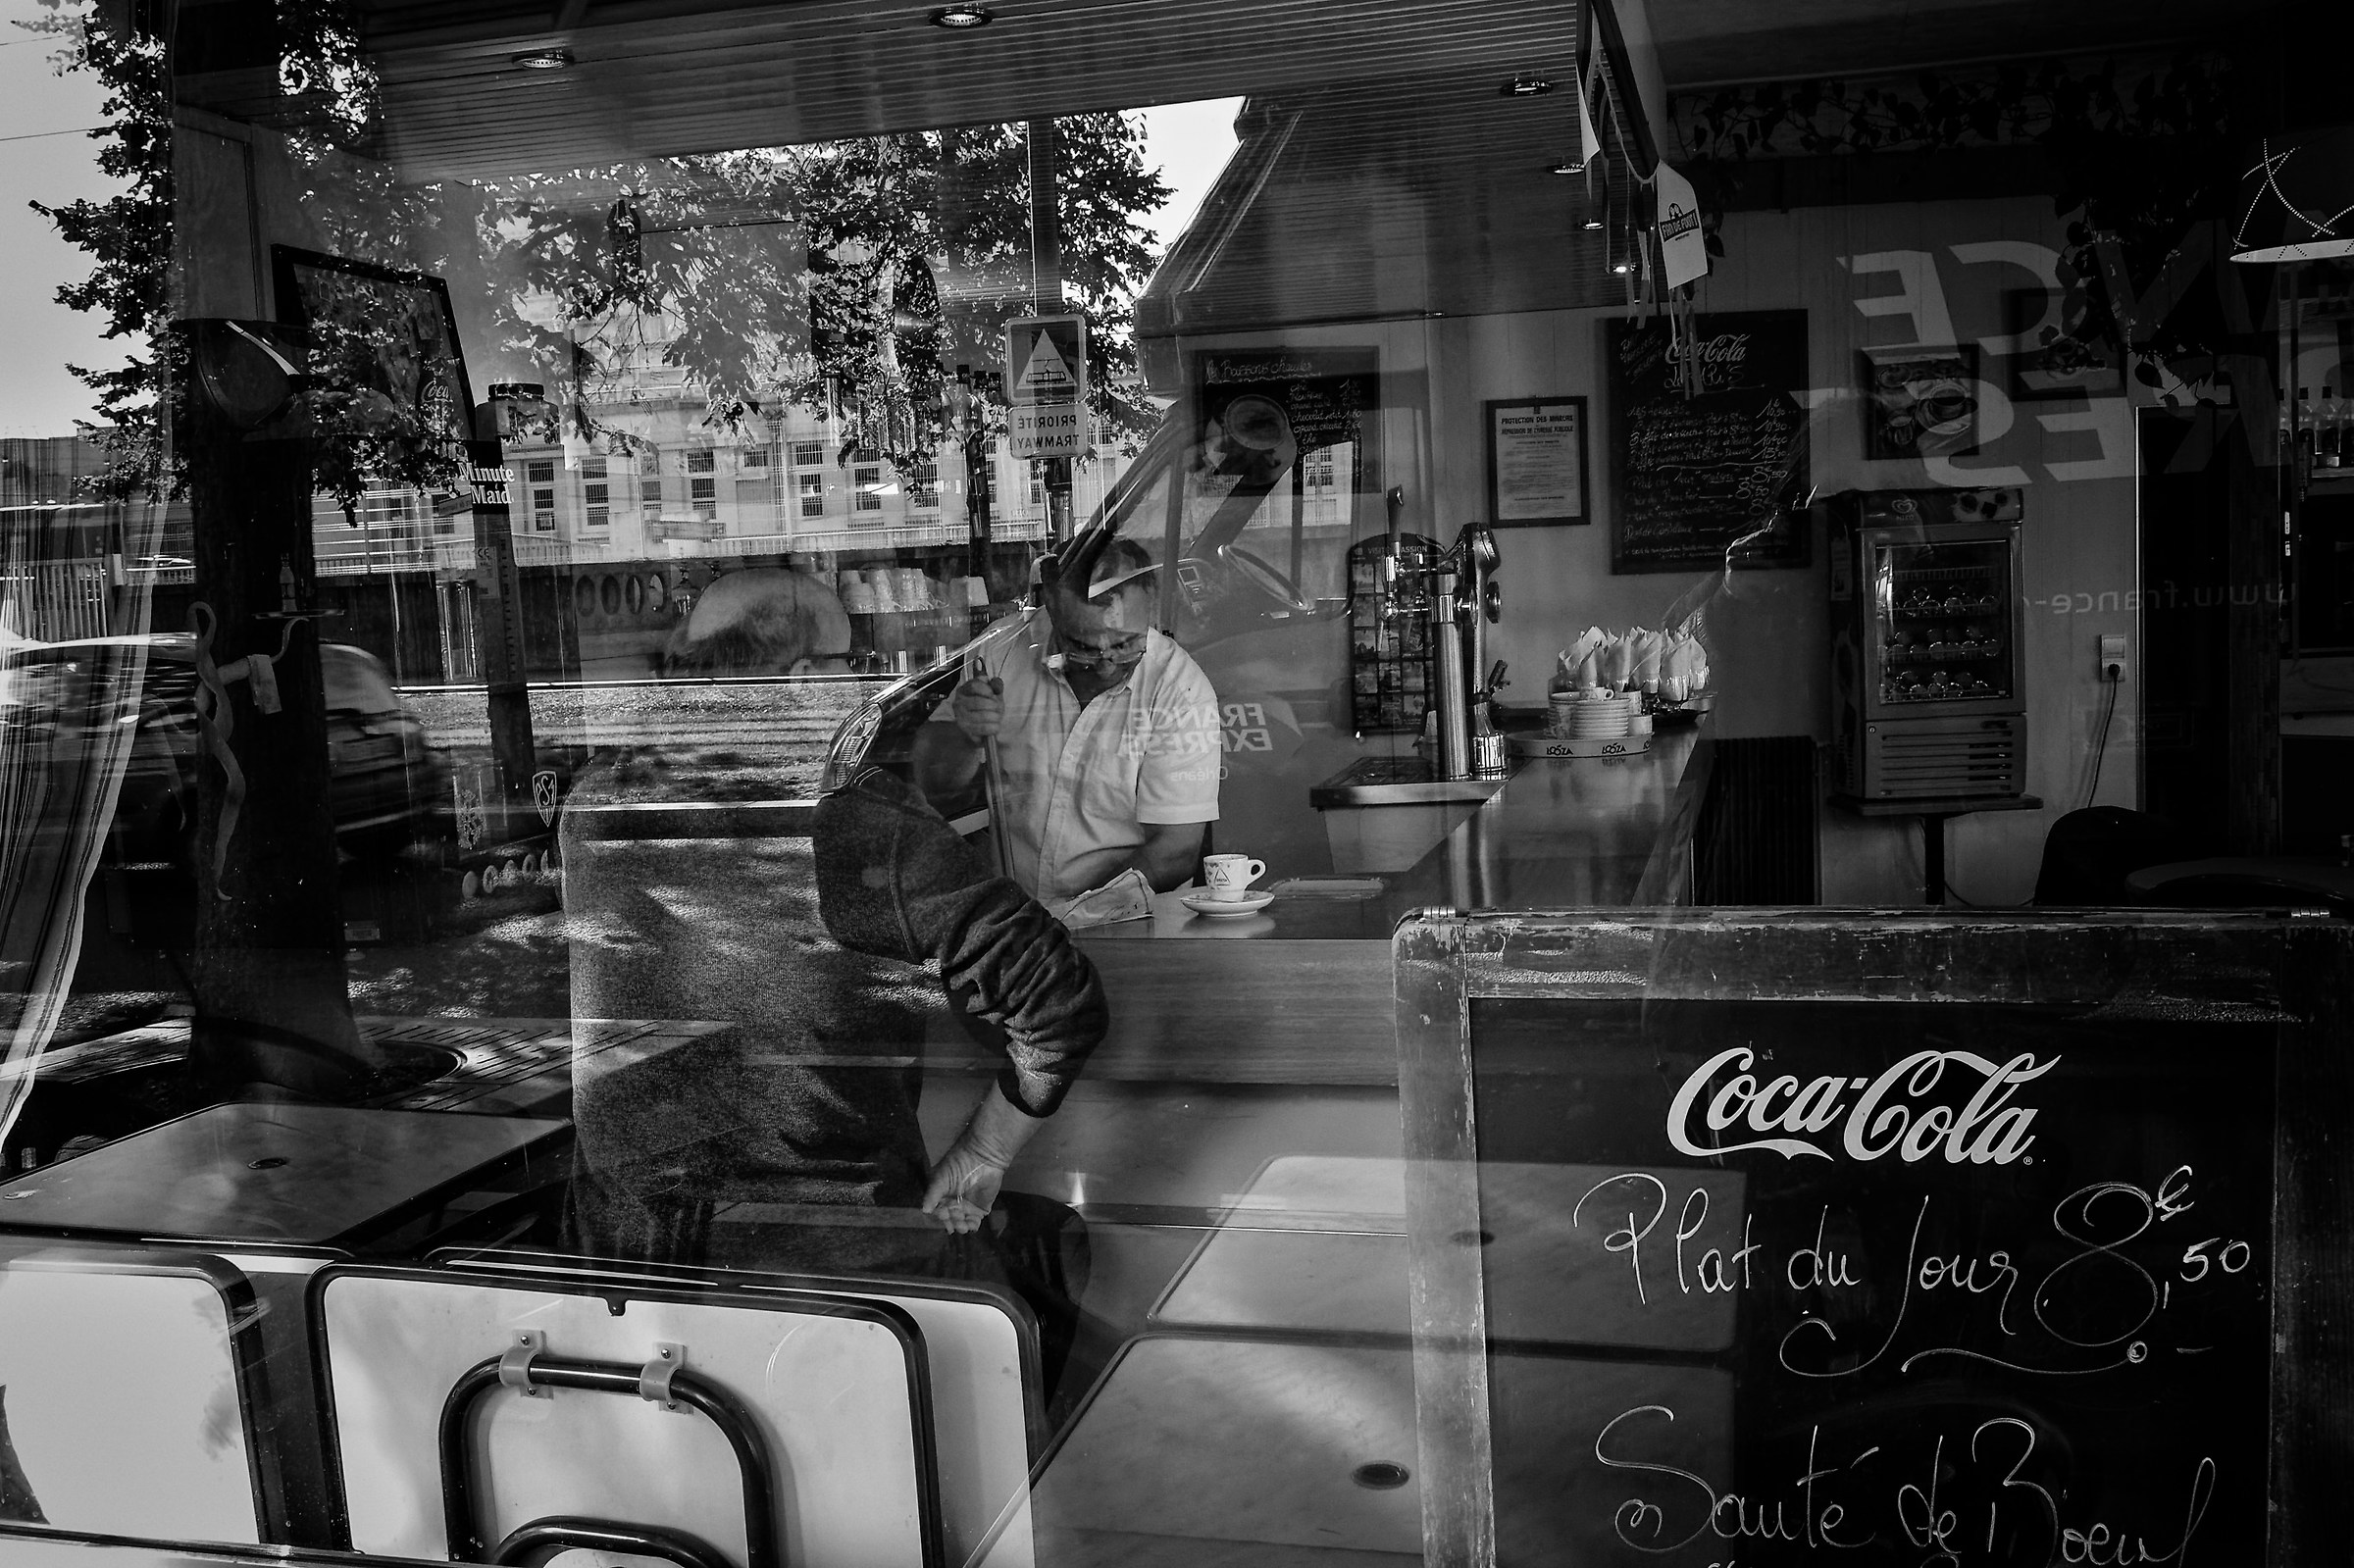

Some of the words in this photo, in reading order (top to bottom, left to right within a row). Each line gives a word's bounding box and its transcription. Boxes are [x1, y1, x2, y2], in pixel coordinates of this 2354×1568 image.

[1664, 333, 1751, 364] Ca-Cola
[457, 461, 515, 482] Minute
[469, 483, 512, 505] Maid
[1401, 545, 1428, 554] ASSION
[1666, 1046, 2063, 1165] Coca-Cola
[1574, 1172, 1762, 1304] Plat
[1786, 1204, 1861, 1290] du
[1596, 1405, 1879, 1553] Sauté
[1896, 1435, 1961, 1552] de
